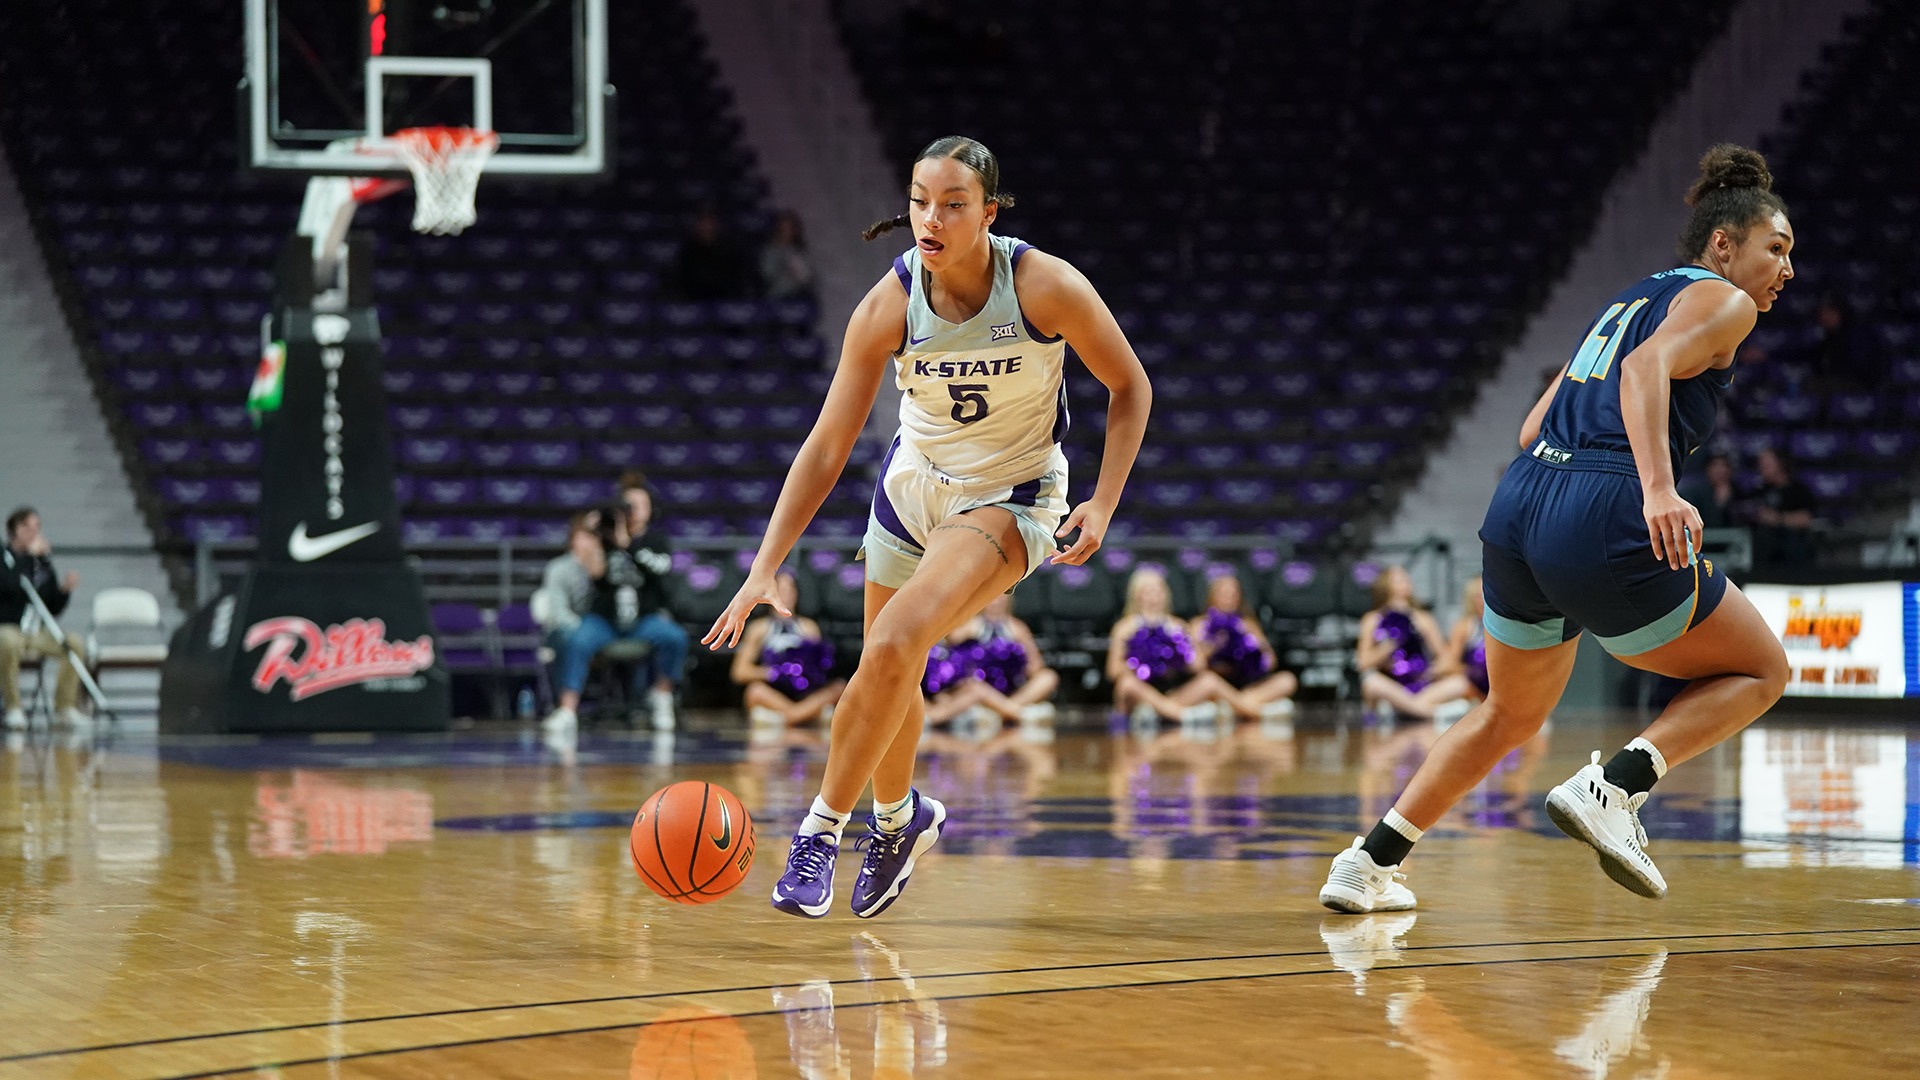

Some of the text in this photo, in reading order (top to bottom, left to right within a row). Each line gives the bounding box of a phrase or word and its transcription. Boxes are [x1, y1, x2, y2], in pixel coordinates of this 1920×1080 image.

[990, 321, 1018, 342] XII
[914, 355, 1022, 378] K-STATE
[947, 384, 990, 425] 5
[243, 615, 435, 700] Dillons
